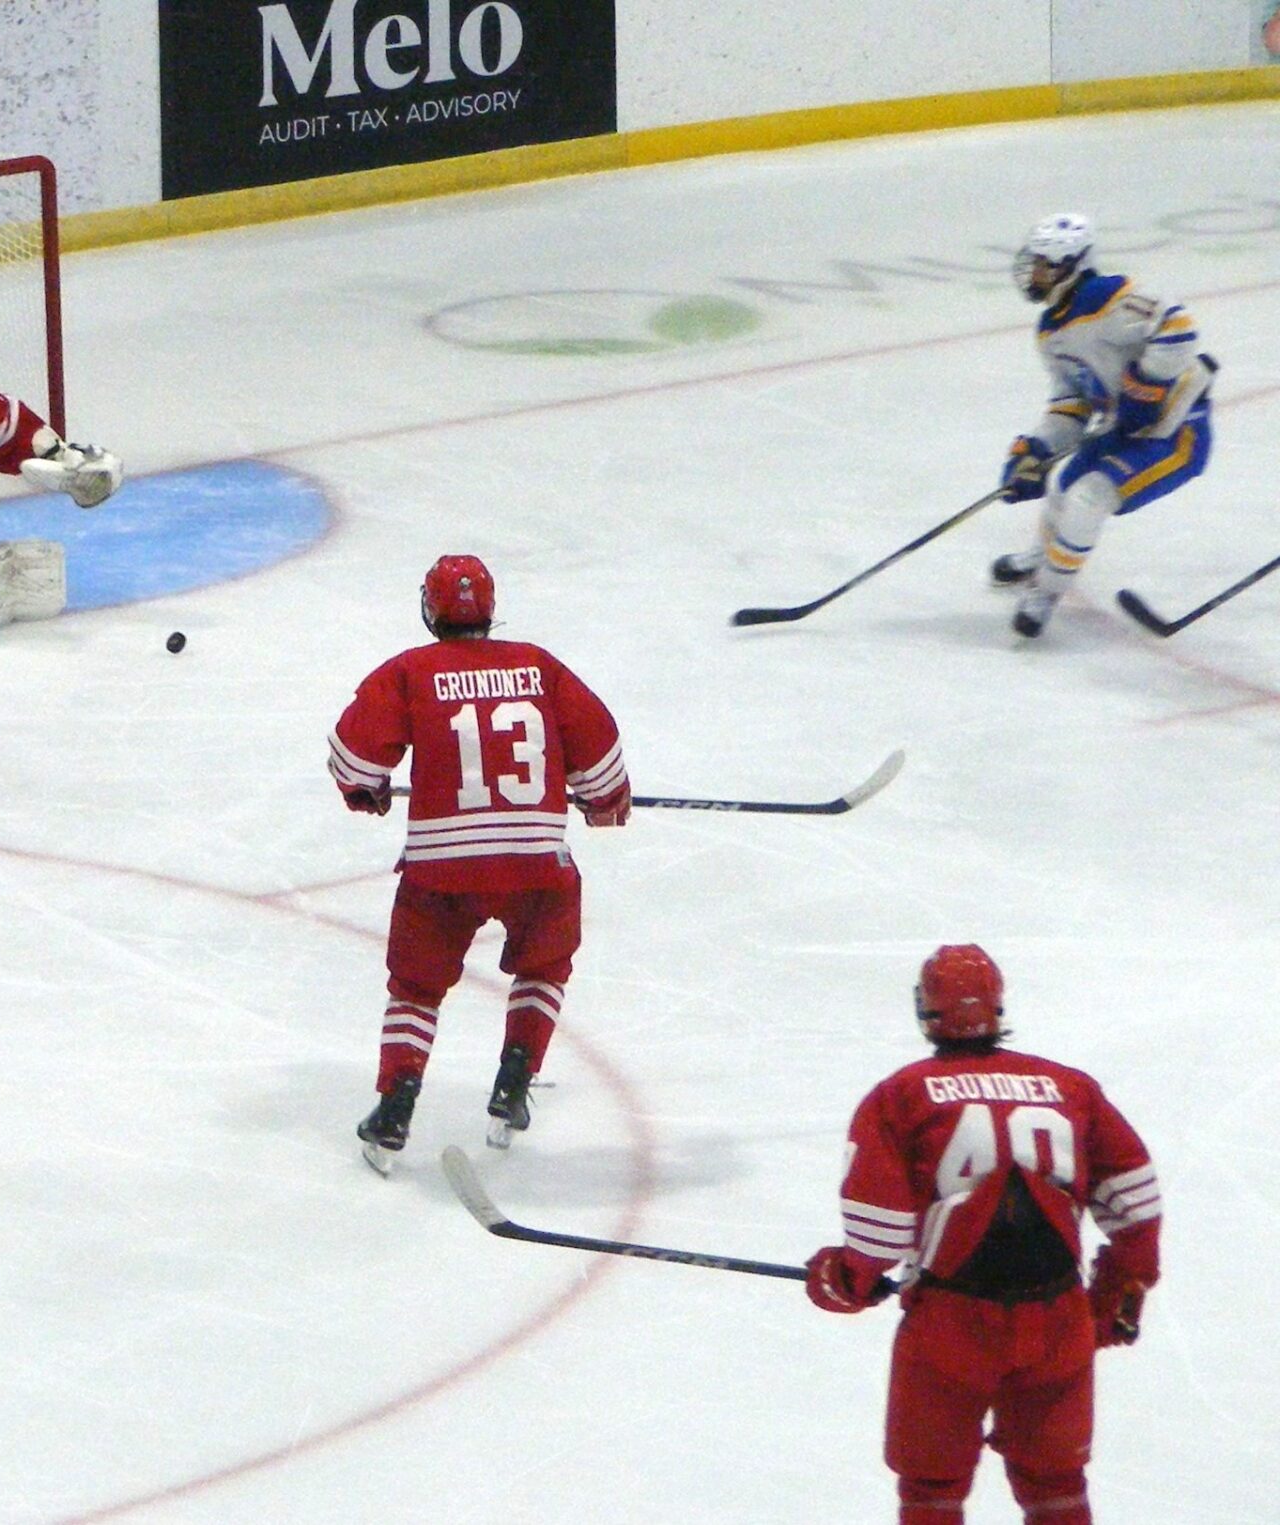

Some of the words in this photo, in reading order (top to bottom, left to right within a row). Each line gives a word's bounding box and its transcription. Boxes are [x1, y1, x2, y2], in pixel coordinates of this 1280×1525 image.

[258, 0, 523, 107] Melo
[259, 115, 330, 144] AUDIT
[347, 107, 388, 132] TAX
[406, 89, 521, 123] ADVISORY
[433, 666, 544, 701] GRUNDNER
[449, 701, 546, 810] 13
[923, 1073, 1064, 1103] GRUNDNER
[936, 1103, 1076, 1198] 40
